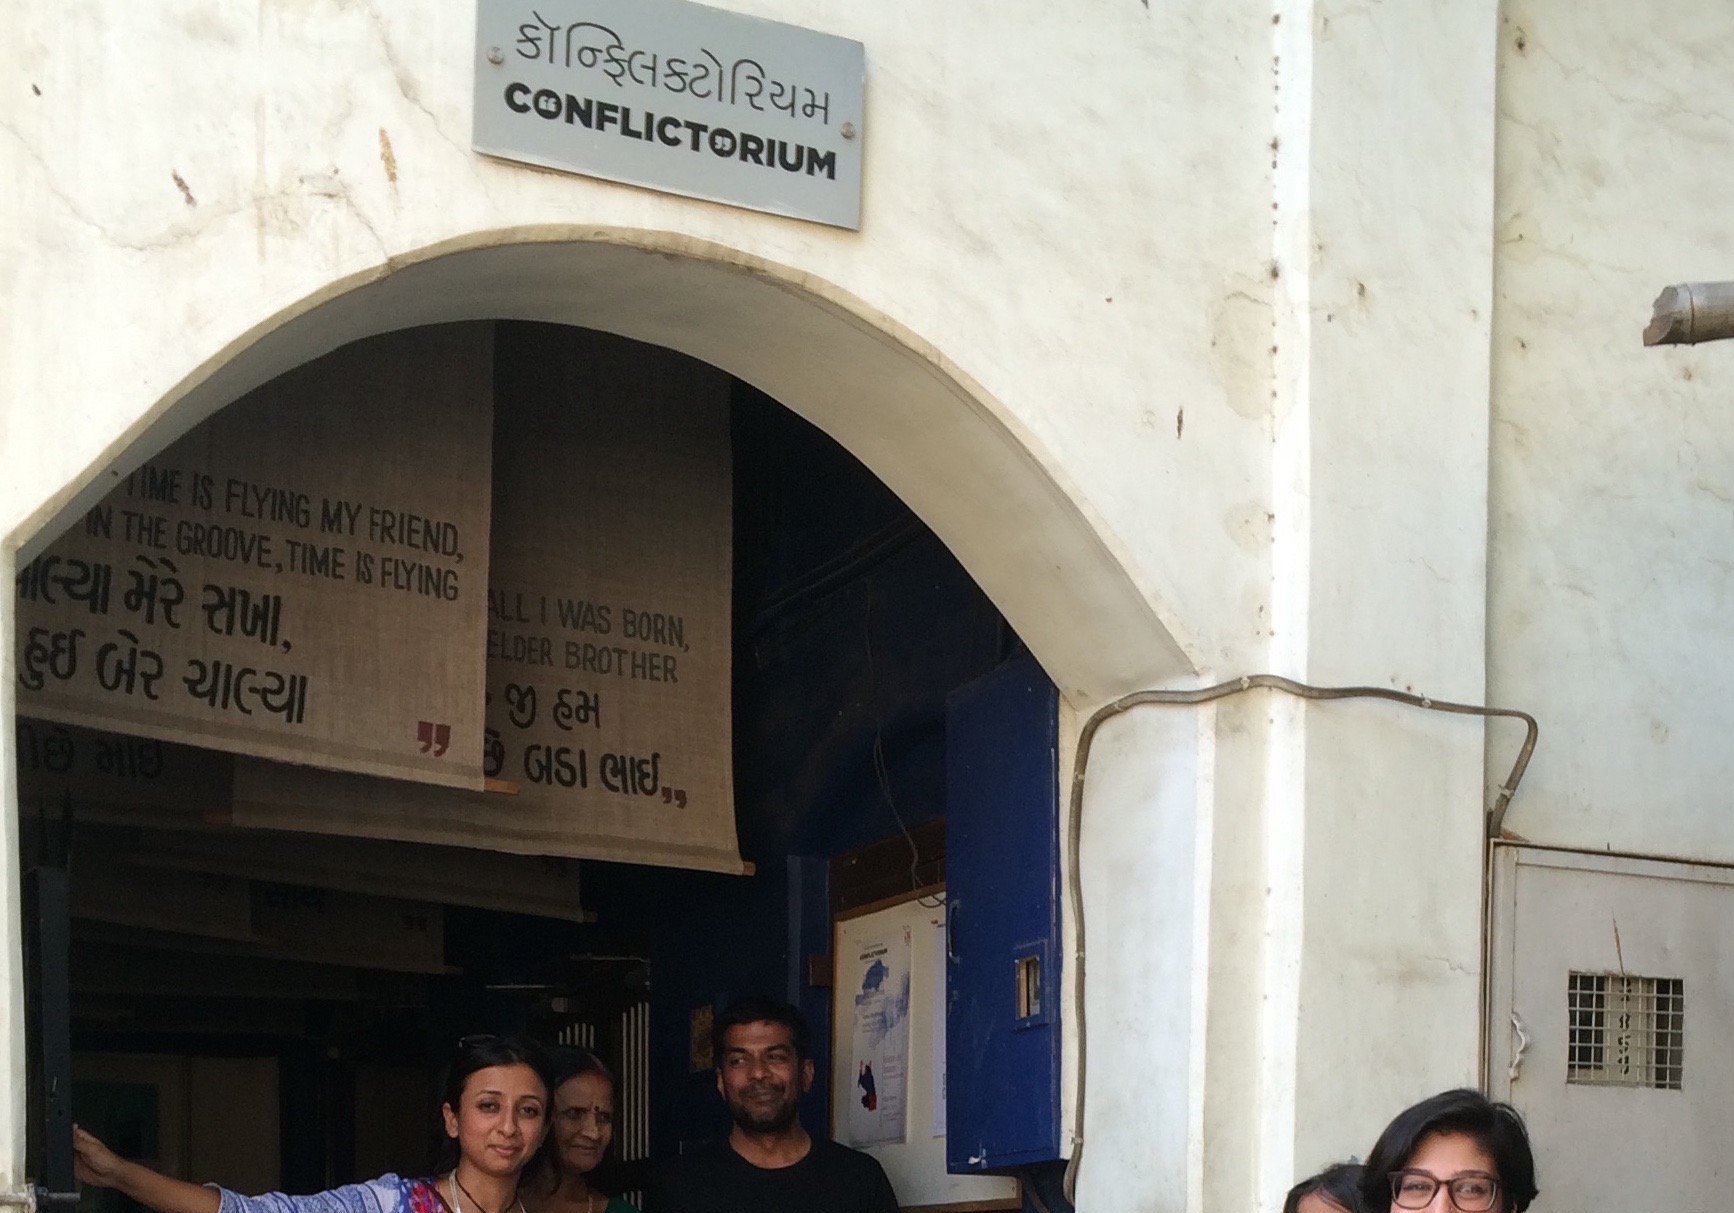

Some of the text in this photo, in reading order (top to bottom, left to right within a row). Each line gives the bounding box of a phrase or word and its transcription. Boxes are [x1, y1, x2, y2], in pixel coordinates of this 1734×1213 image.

[503, 81, 837, 181] CONFLICTORIUM
[121, 509, 168, 549] THE
[285, 538, 346, 581] TIME
[355, 550, 375, 585] IS
[380, 556, 459, 602] FLYING
[191, 473, 214, 513] IS
[225, 477, 311, 530] FLYING
[320, 498, 361, 537] MY
[368, 508, 465, 564] FRIEND,
[123, 553, 185, 630] મેરે
[539, 594, 547, 626] I
[556, 596, 612, 635] WAS
[622, 608, 690, 653] BORN,
[182, 657, 308, 725] ચાલ્યા
[487, 628, 679, 684] ELDER BROTHER
